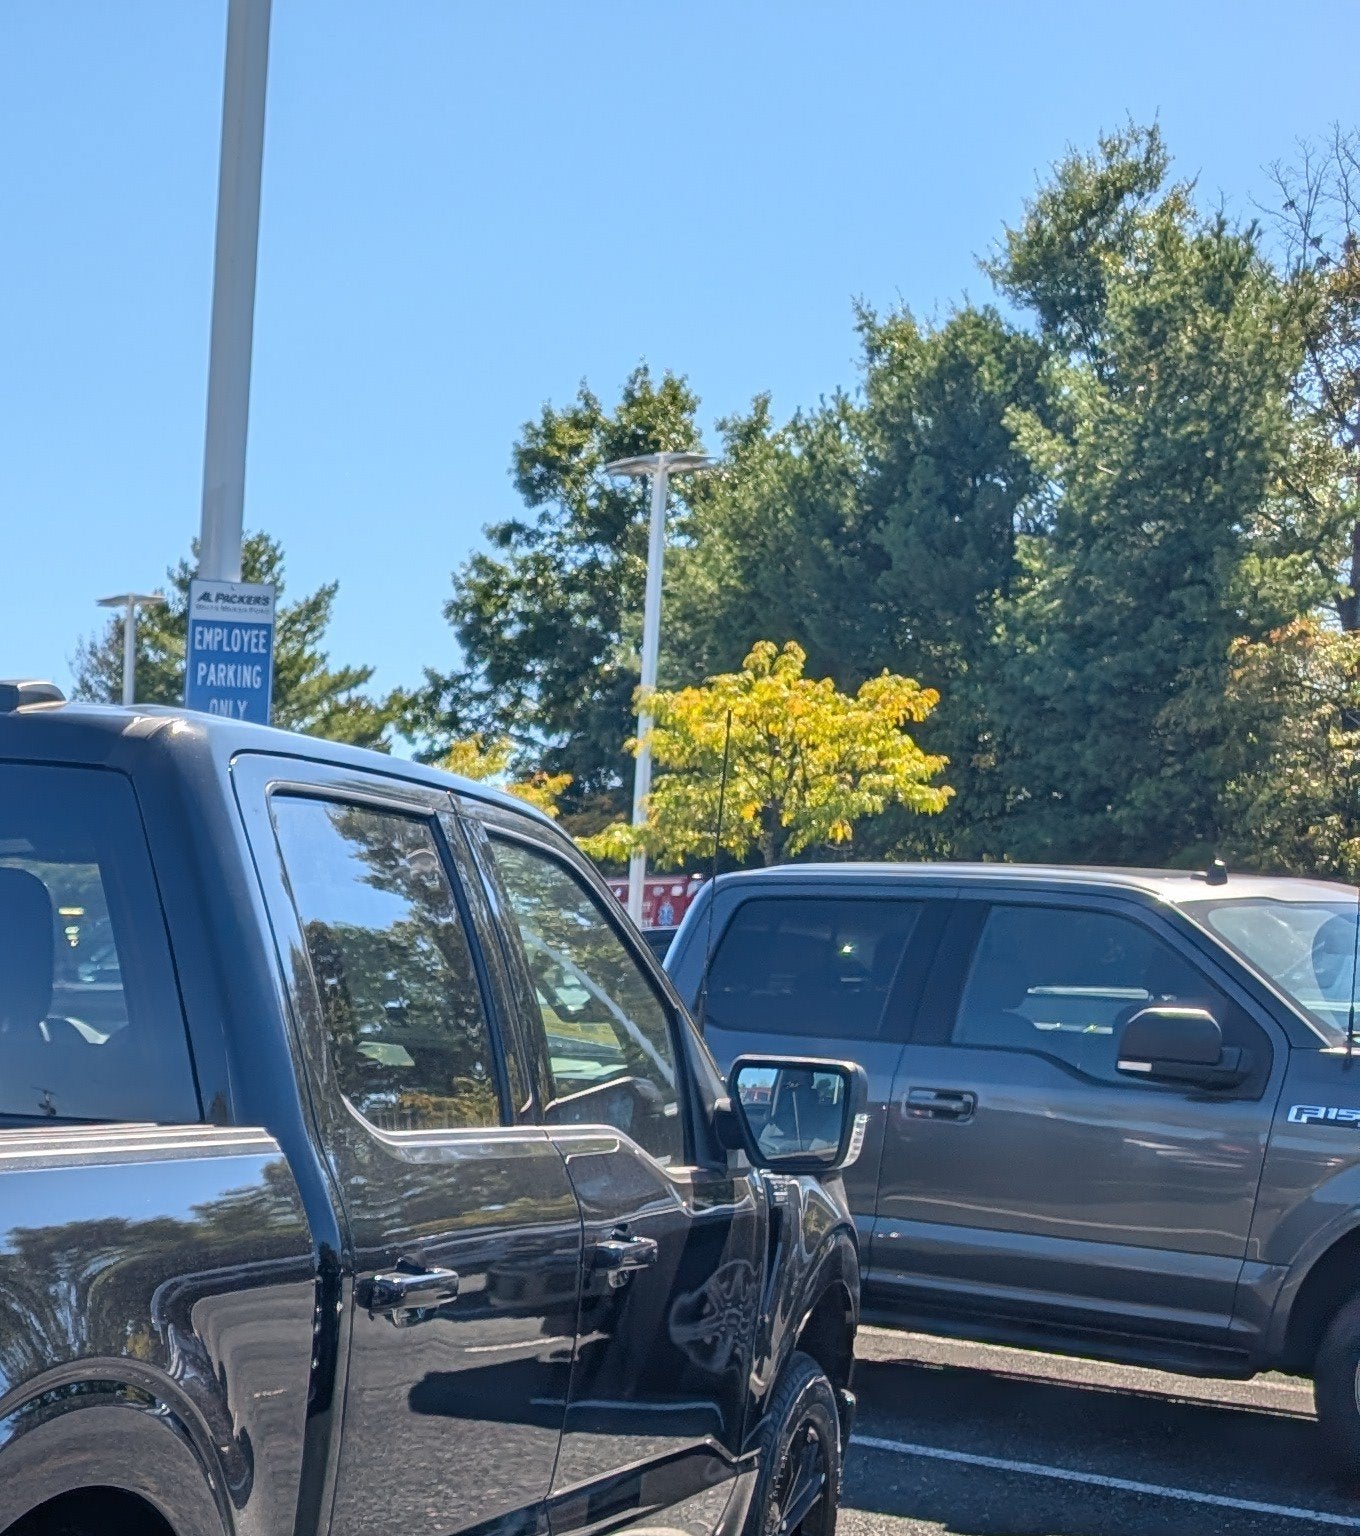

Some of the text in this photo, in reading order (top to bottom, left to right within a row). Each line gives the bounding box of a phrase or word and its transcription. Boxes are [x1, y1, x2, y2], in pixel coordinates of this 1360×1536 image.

[194, 626, 267, 654] EMPLOYEE
[196, 662, 262, 690] PARKING
[209, 697, 249, 721] ONLY
